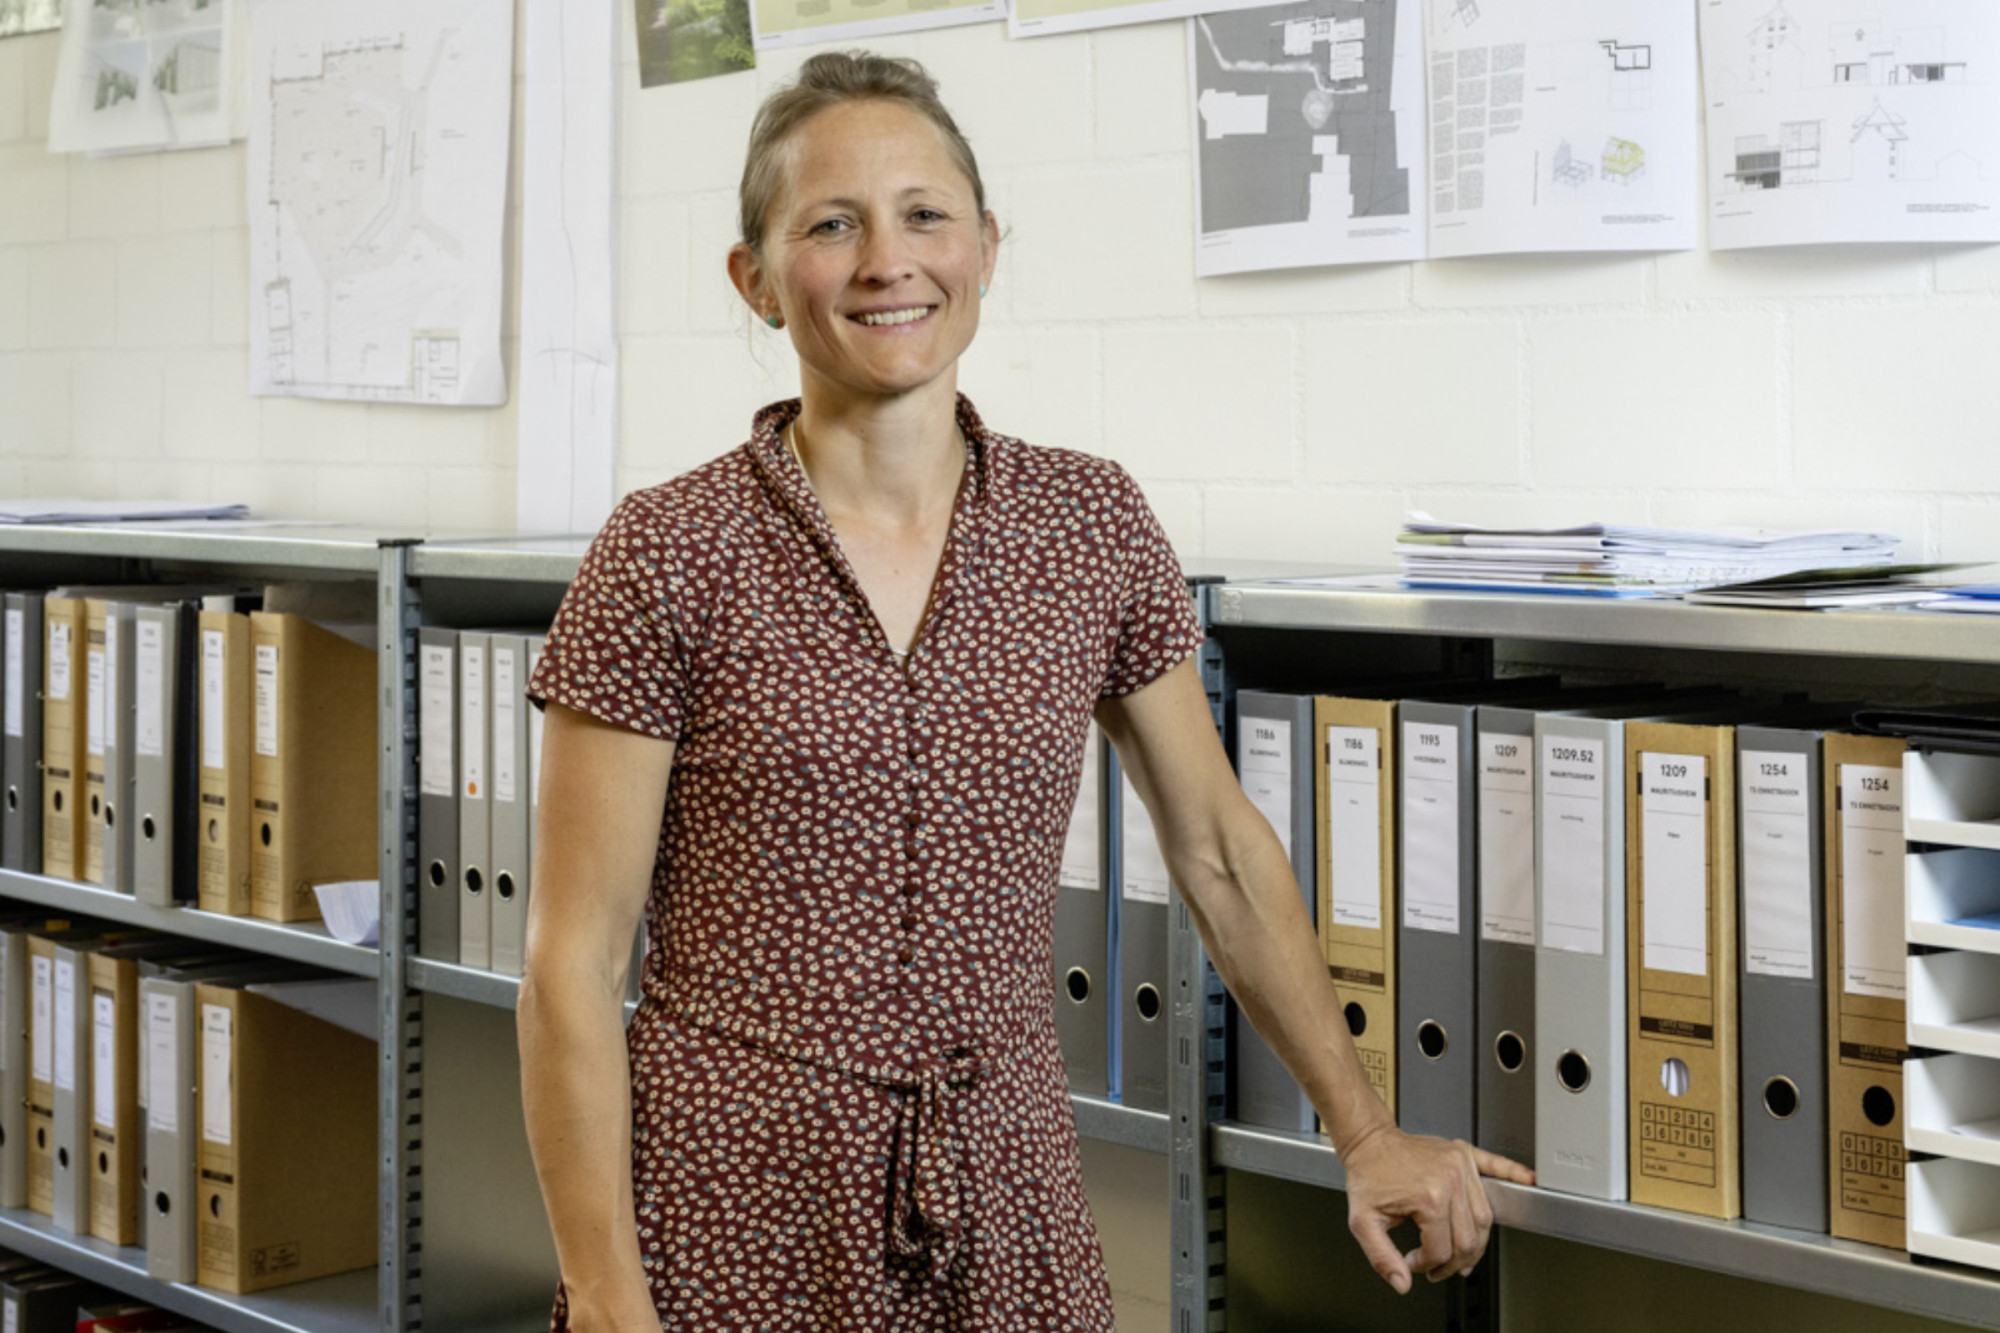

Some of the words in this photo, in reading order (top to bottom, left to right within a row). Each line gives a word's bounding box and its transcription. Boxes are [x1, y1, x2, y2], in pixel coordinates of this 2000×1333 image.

[1255, 728, 1275, 741] 1186
[1419, 734, 1441, 747] 1193
[1344, 738, 1363, 750] 1186
[1495, 744, 1518, 757] 1209
[1552, 747, 1594, 763] 1209.52
[1660, 764, 1687, 778] 1209
[1759, 763, 1788, 777] 1254
[1861, 777, 1889, 791] 1254
[1644, 1107, 1651, 1119] 0
[1659, 1109, 1665, 1120] 1
[1673, 1112, 1681, 1123] 2
[1687, 1114, 1695, 1125] 3
[1703, 1116, 1711, 1128] 4
[1644, 1125, 1651, 1137] 5
[1658, 1128, 1666, 1139] 6
[1673, 1130, 1681, 1141] 7
[1688, 1132, 1696, 1144] 8
[1703, 1135, 1711, 1146] 9
[1844, 1137, 1852, 1149] 0
[1860, 1140, 1866, 1151] 1
[1876, 1142, 1884, 1154] 2
[1892, 1145, 1899, 1157] 3
[1876, 1161, 1883, 1173] 7
